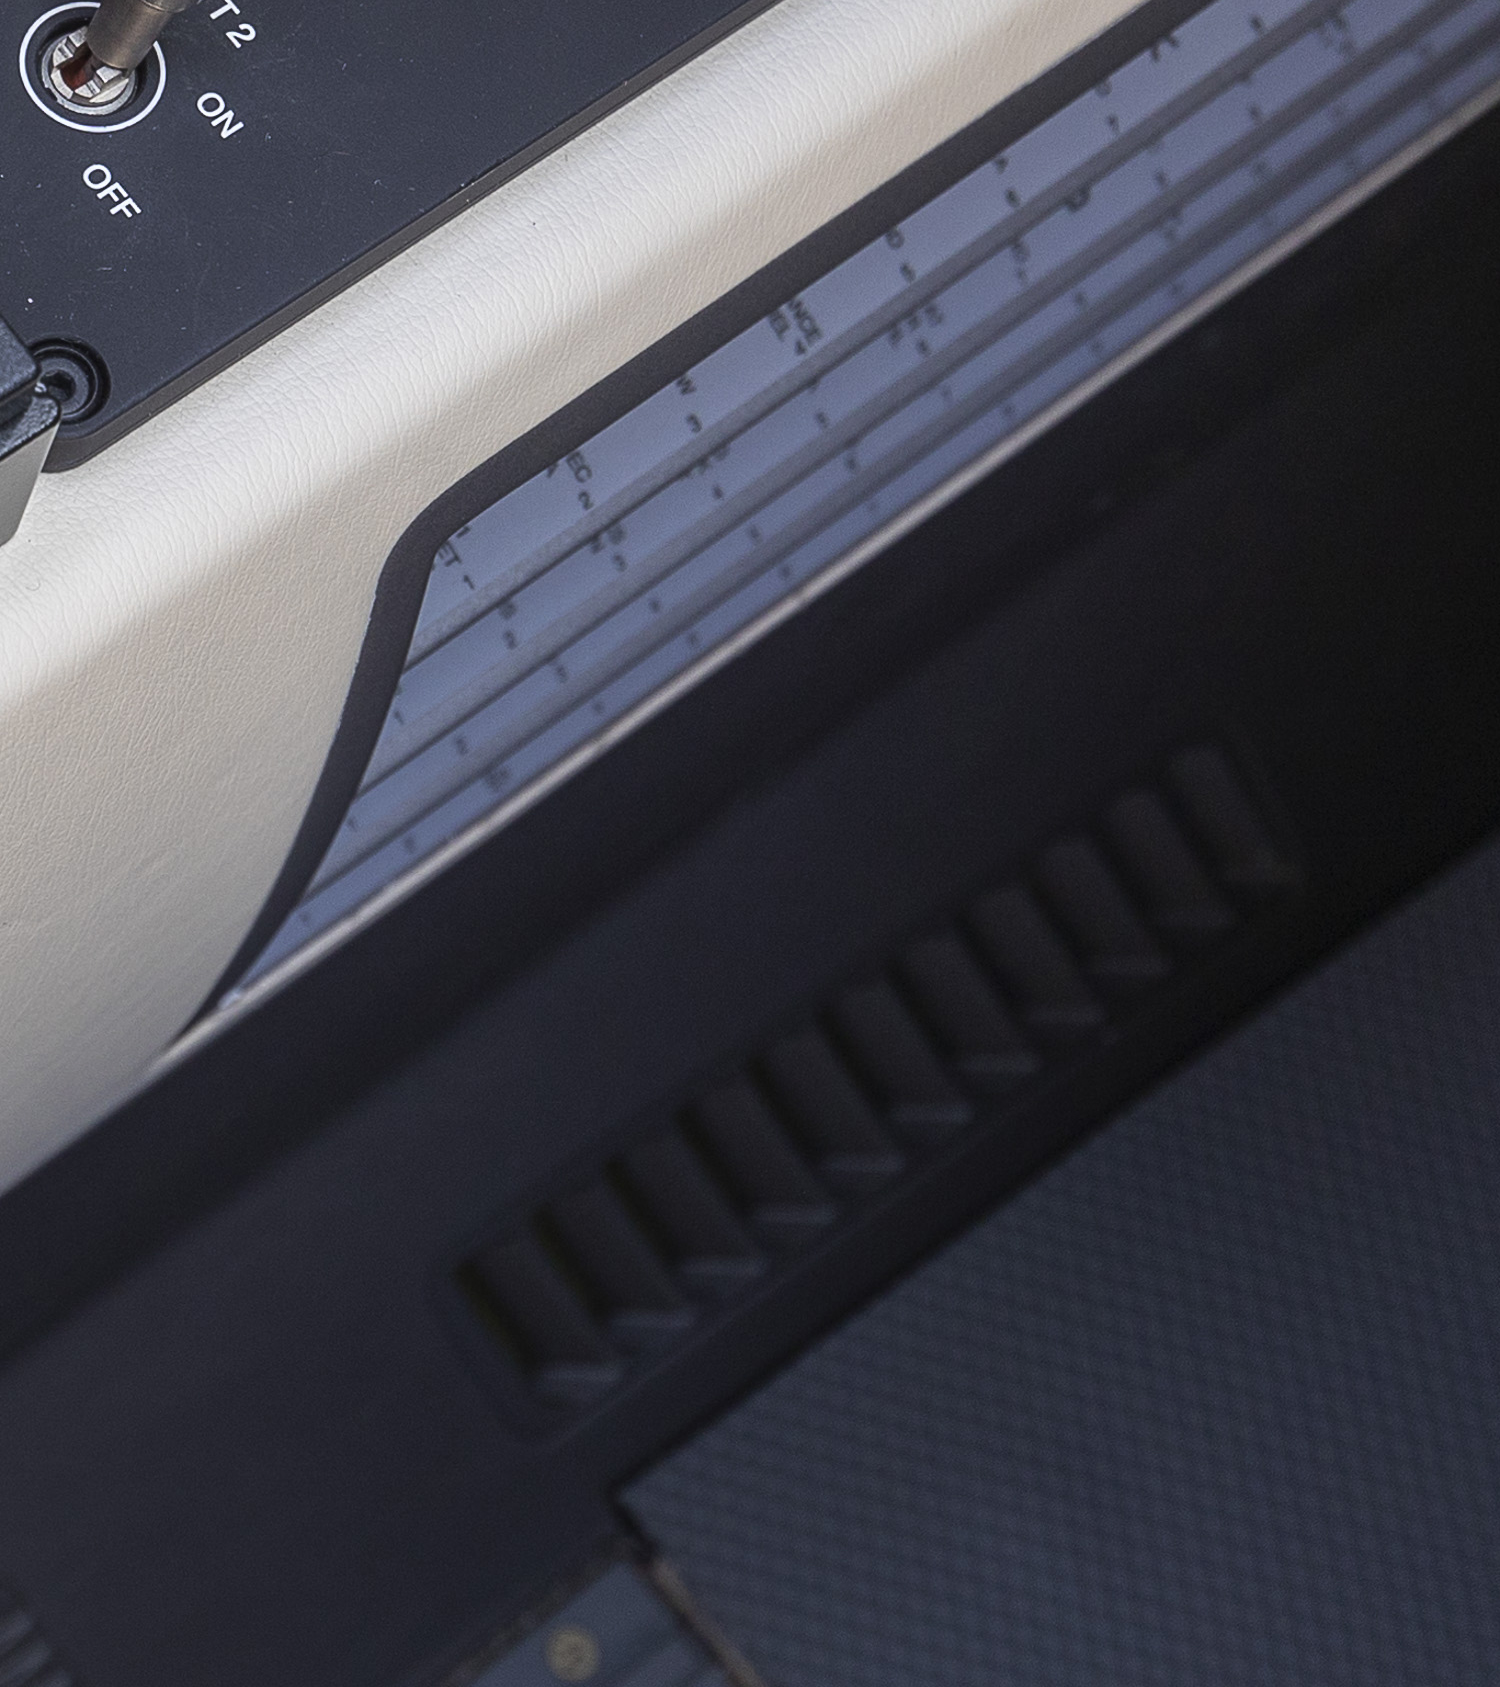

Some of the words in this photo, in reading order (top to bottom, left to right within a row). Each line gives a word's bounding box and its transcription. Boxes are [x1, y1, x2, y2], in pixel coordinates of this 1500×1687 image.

[225, 22, 257, 49] 2
[197, 93, 244, 138] ON
[83, 164, 141, 217] OFF
